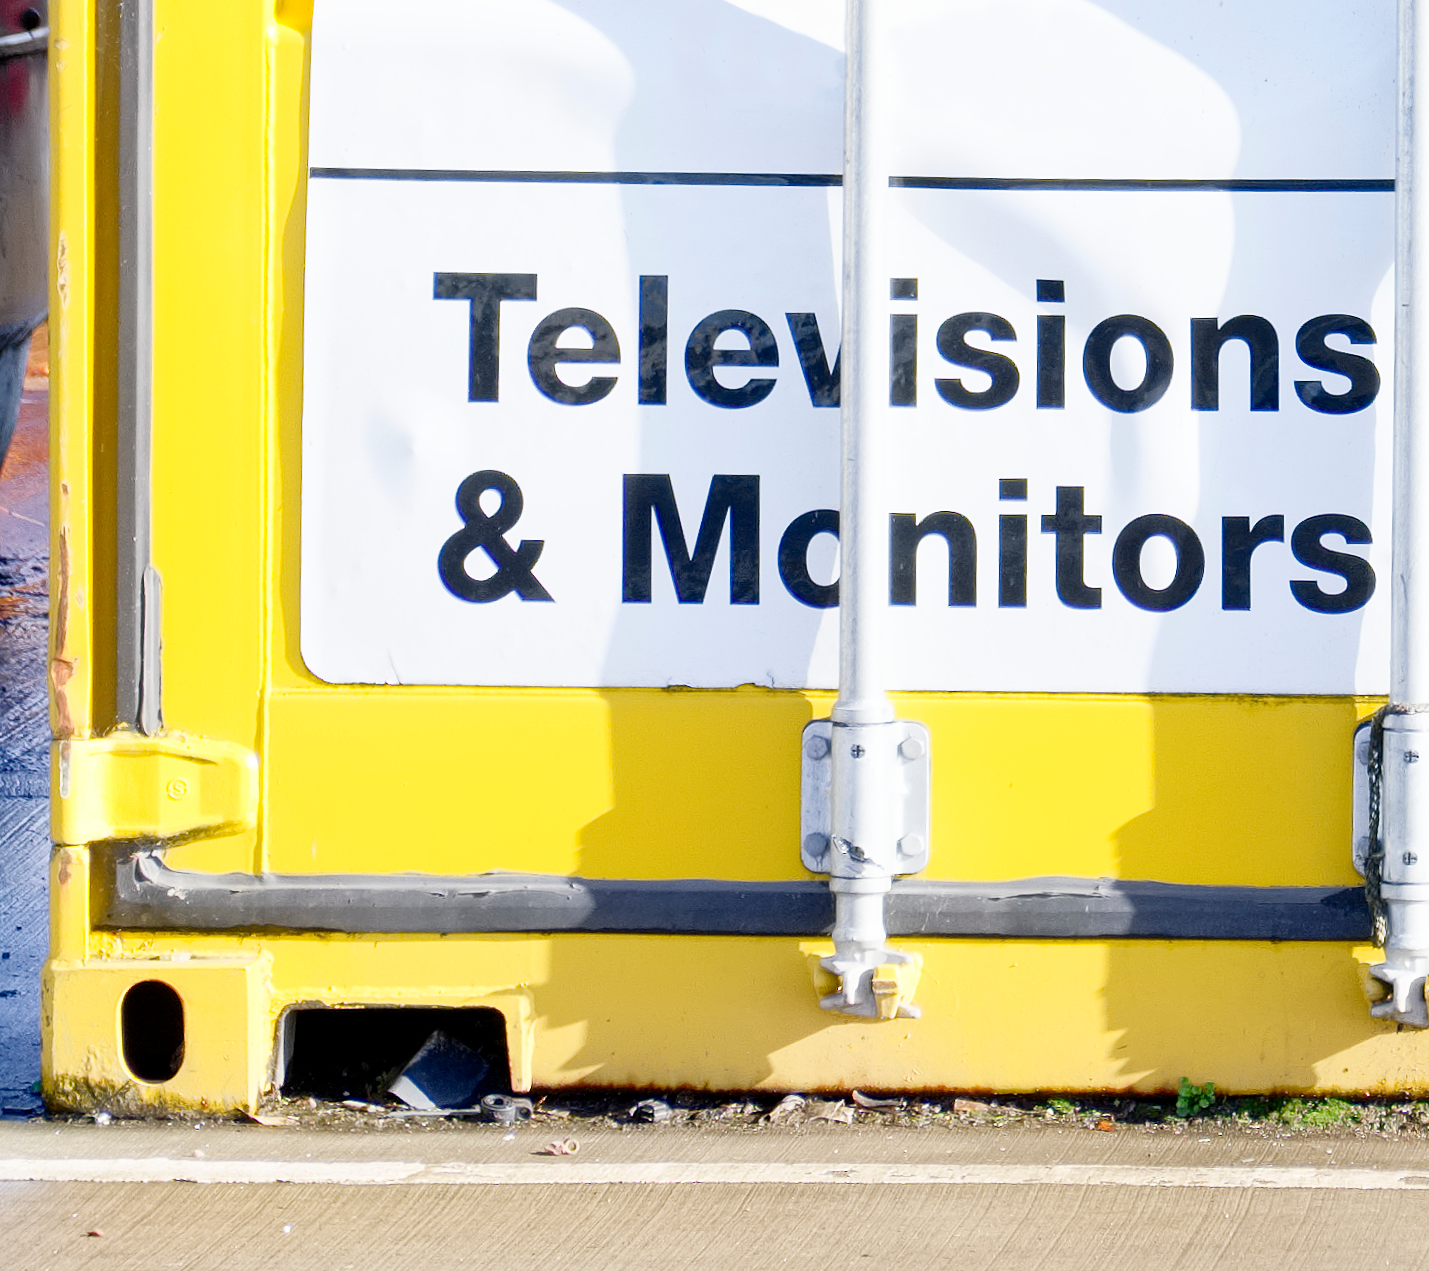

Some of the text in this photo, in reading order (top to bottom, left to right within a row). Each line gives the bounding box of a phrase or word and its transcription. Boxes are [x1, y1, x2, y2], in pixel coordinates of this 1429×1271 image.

[433, 272, 1381, 415] Televisions
[436, 469, 1376, 615] & Monitors
